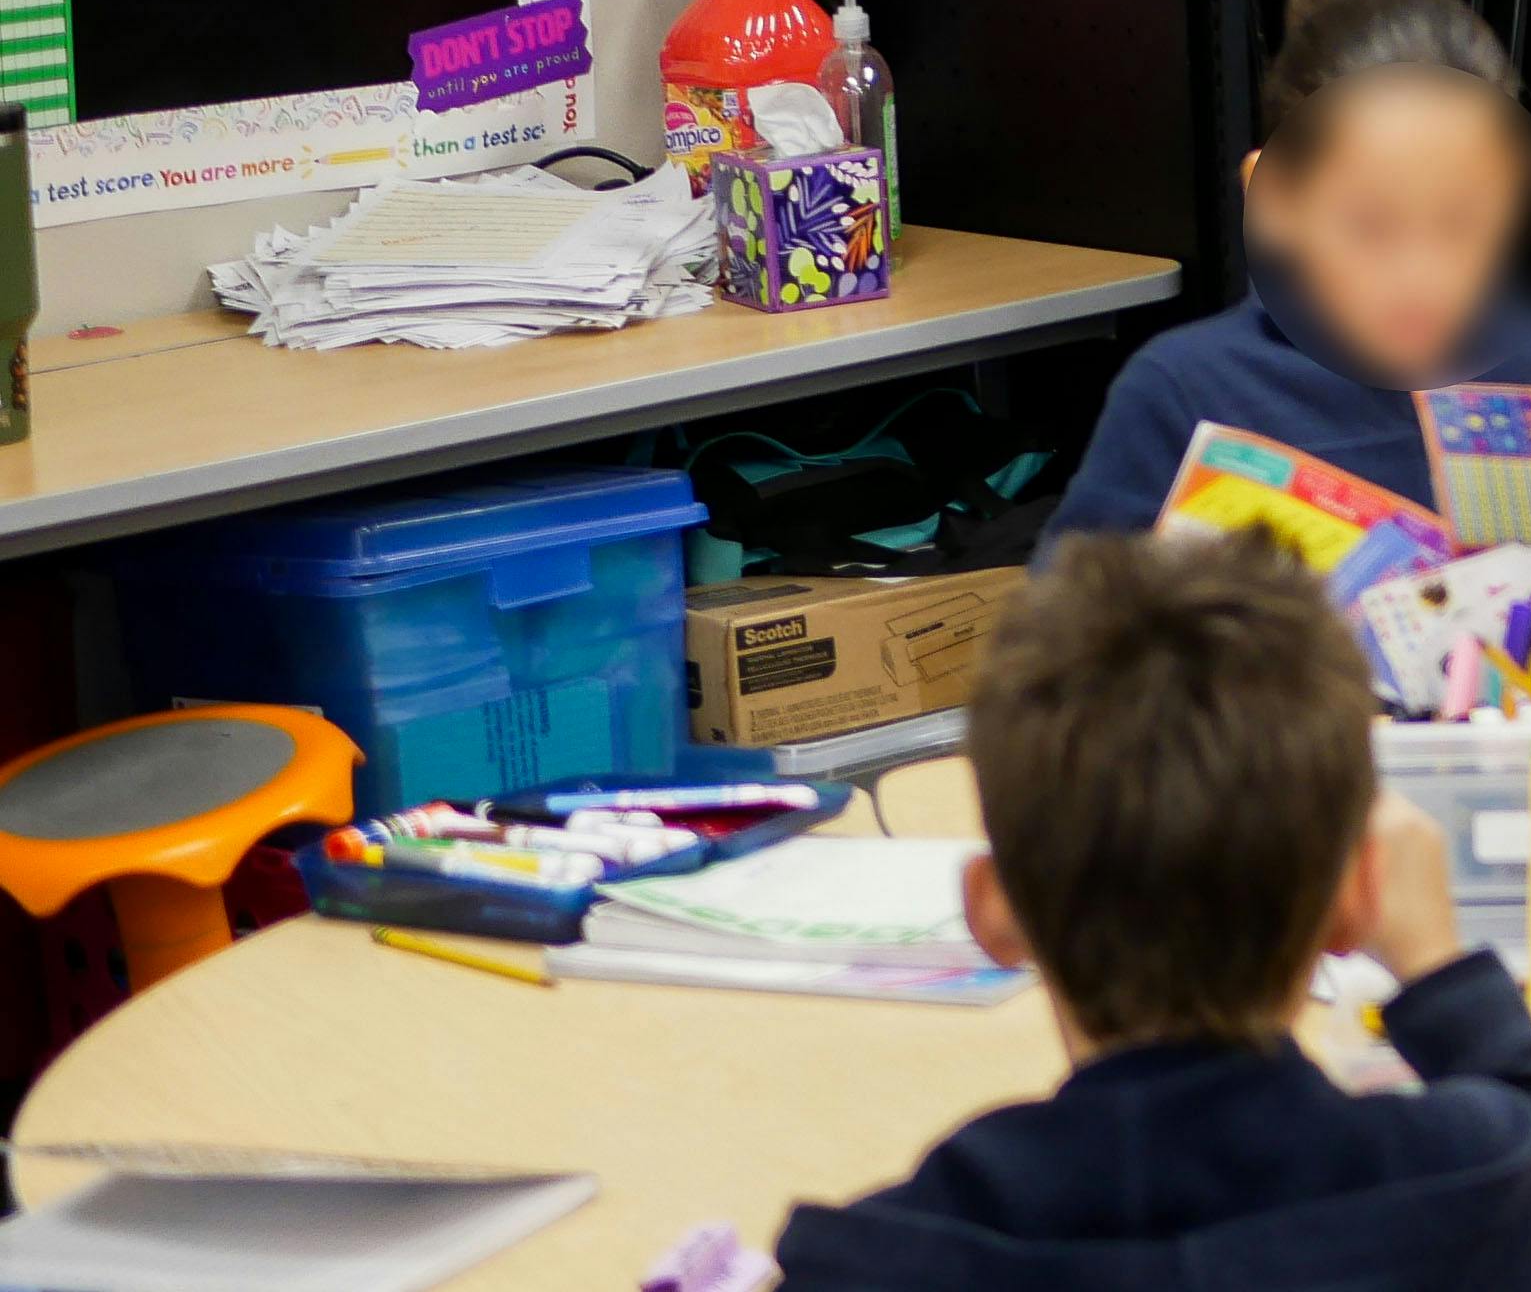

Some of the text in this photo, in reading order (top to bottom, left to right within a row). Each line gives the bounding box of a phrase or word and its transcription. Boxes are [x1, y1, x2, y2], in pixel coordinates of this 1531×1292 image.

[421, 9, 574, 79] DON'T STOP
[427, 47, 581, 101] until you are proud
[47, 155, 295, 204] test score You are more
[744, 620, 802, 646] Scotch
